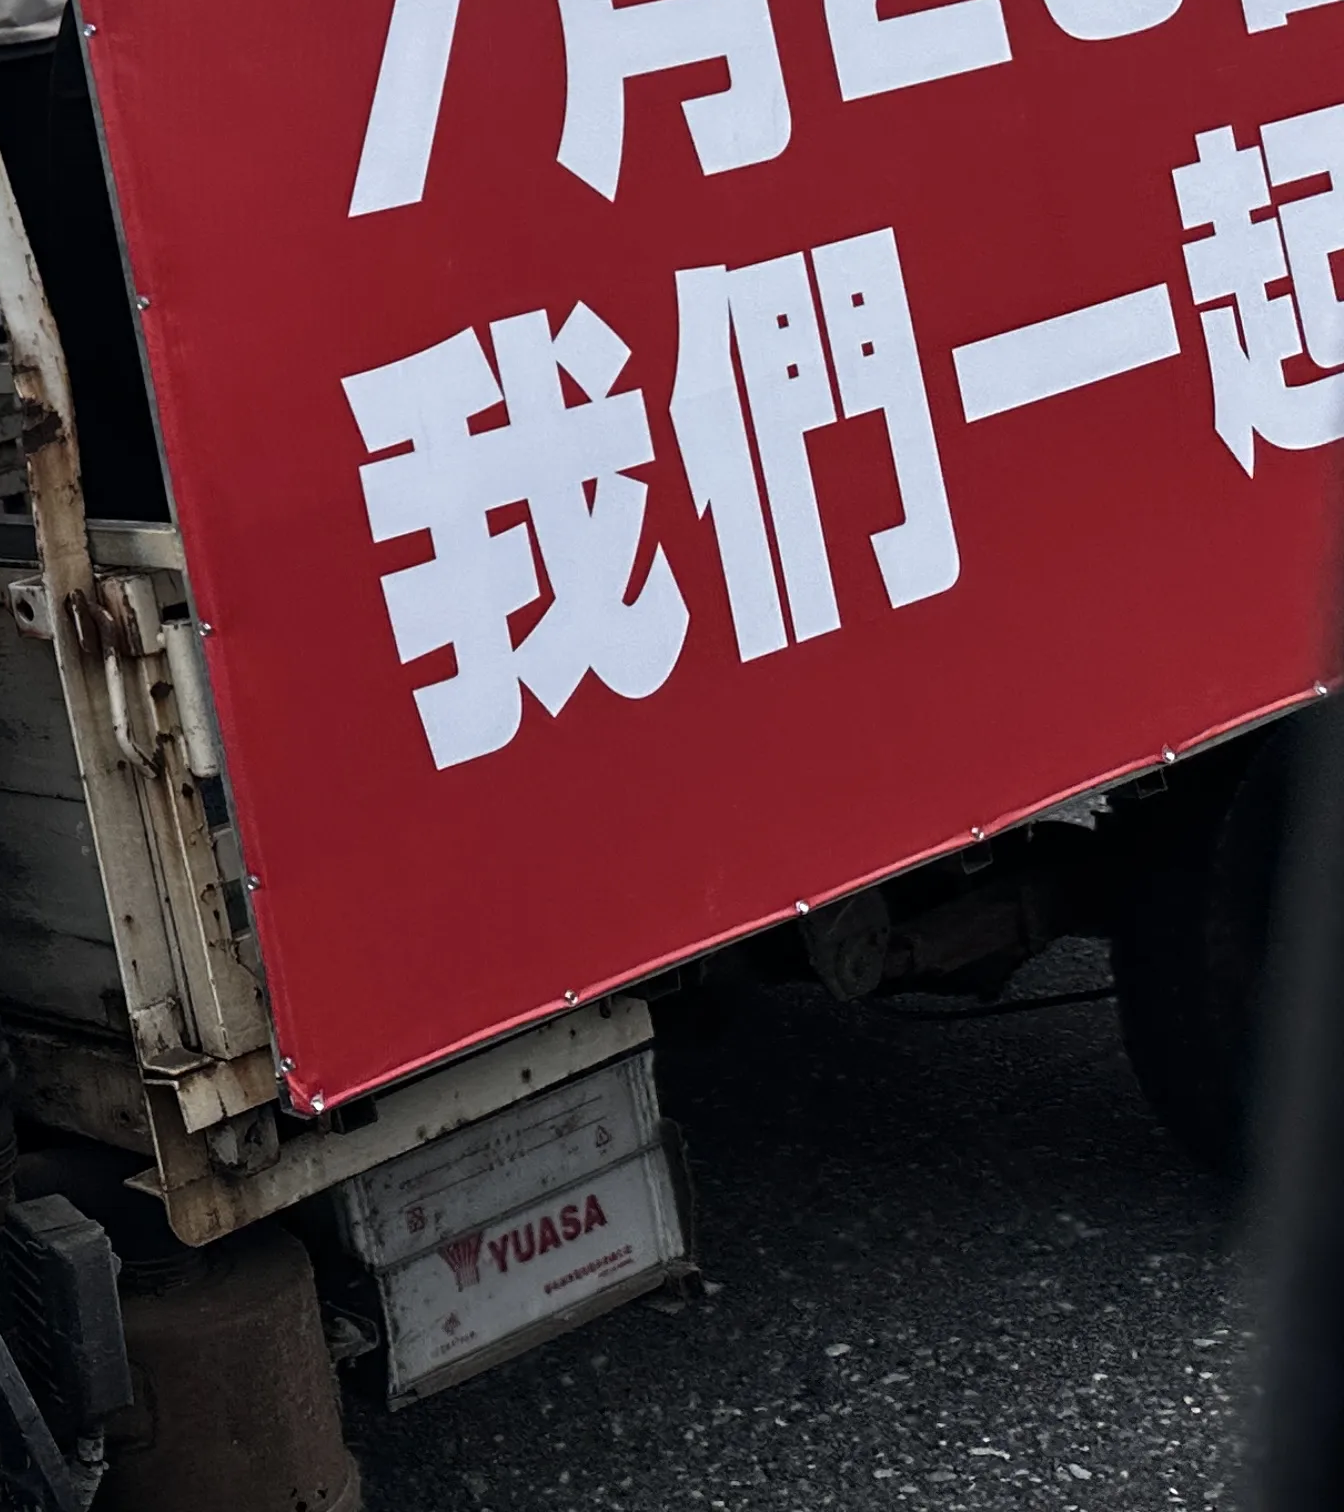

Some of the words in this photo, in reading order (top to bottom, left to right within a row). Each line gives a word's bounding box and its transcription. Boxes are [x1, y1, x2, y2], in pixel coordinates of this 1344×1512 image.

[340, 103, 1344, 770] 我們一起
[487, 1193, 608, 1273] YUASA
